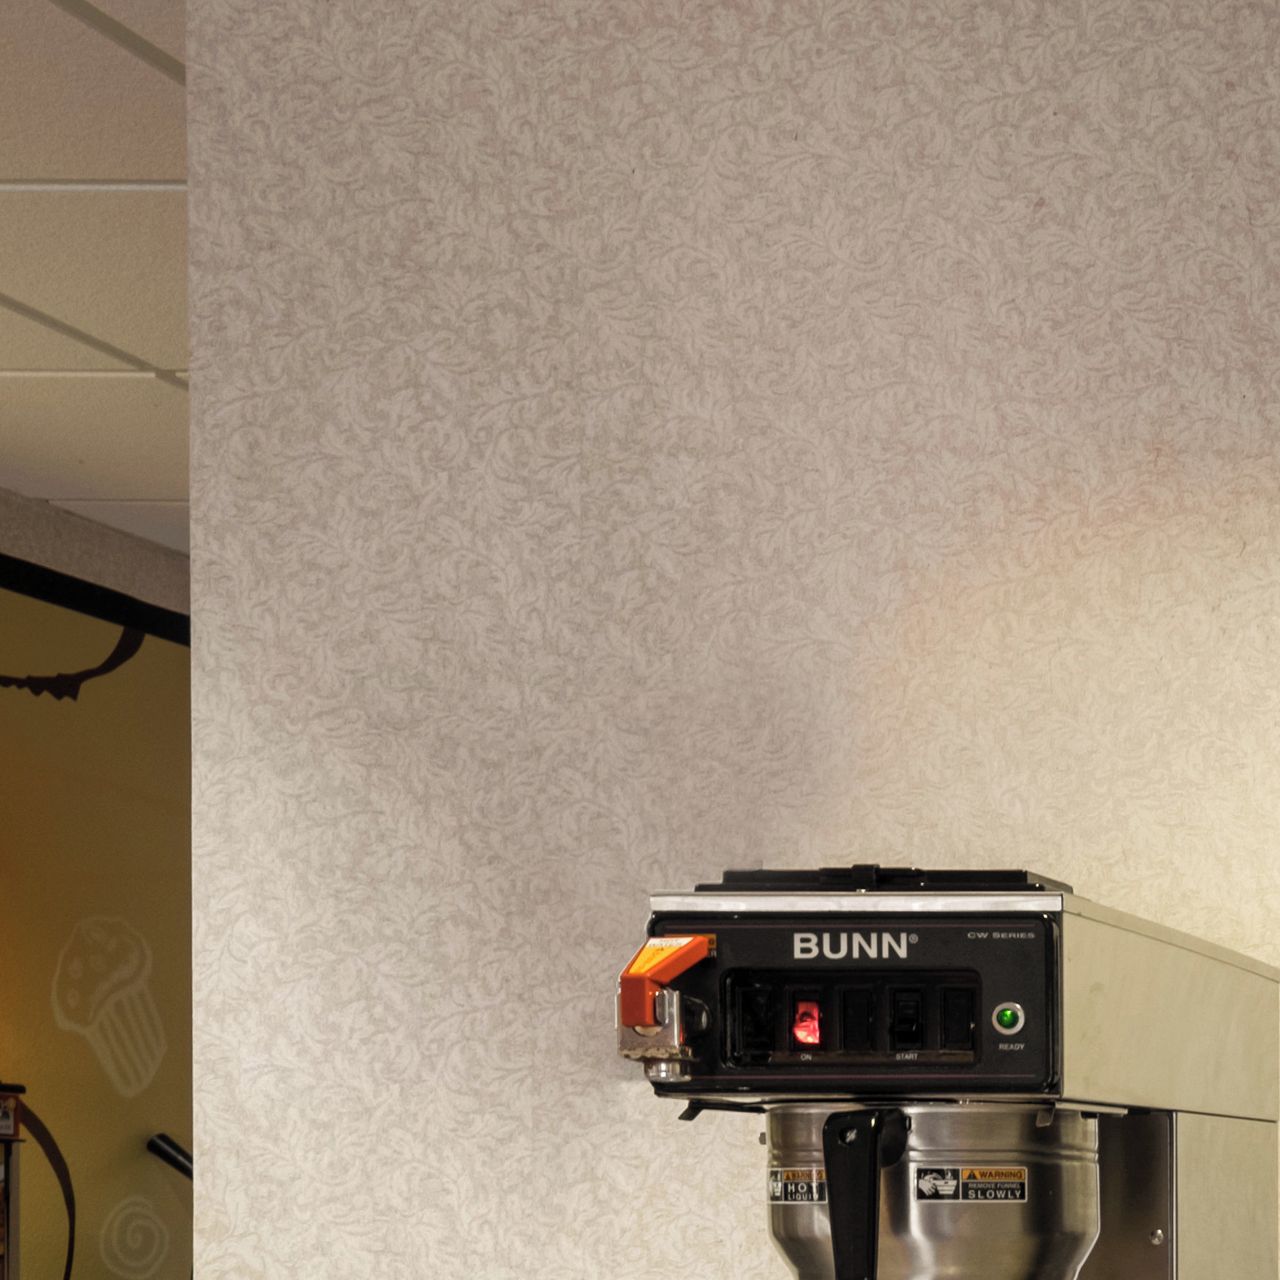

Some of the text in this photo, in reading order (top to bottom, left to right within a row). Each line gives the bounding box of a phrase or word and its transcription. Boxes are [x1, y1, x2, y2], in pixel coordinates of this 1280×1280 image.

[992, 931, 1036, 940] SERIES
[998, 1043, 1025, 1051] READY
[800, 1053, 812, 1061] ON
[895, 1052, 919, 1061] START
[978, 1170, 1023, 1179] WARNING
[787, 1182, 819, 1193] HOT
[967, 1189, 1022, 1199] SLOWLY
